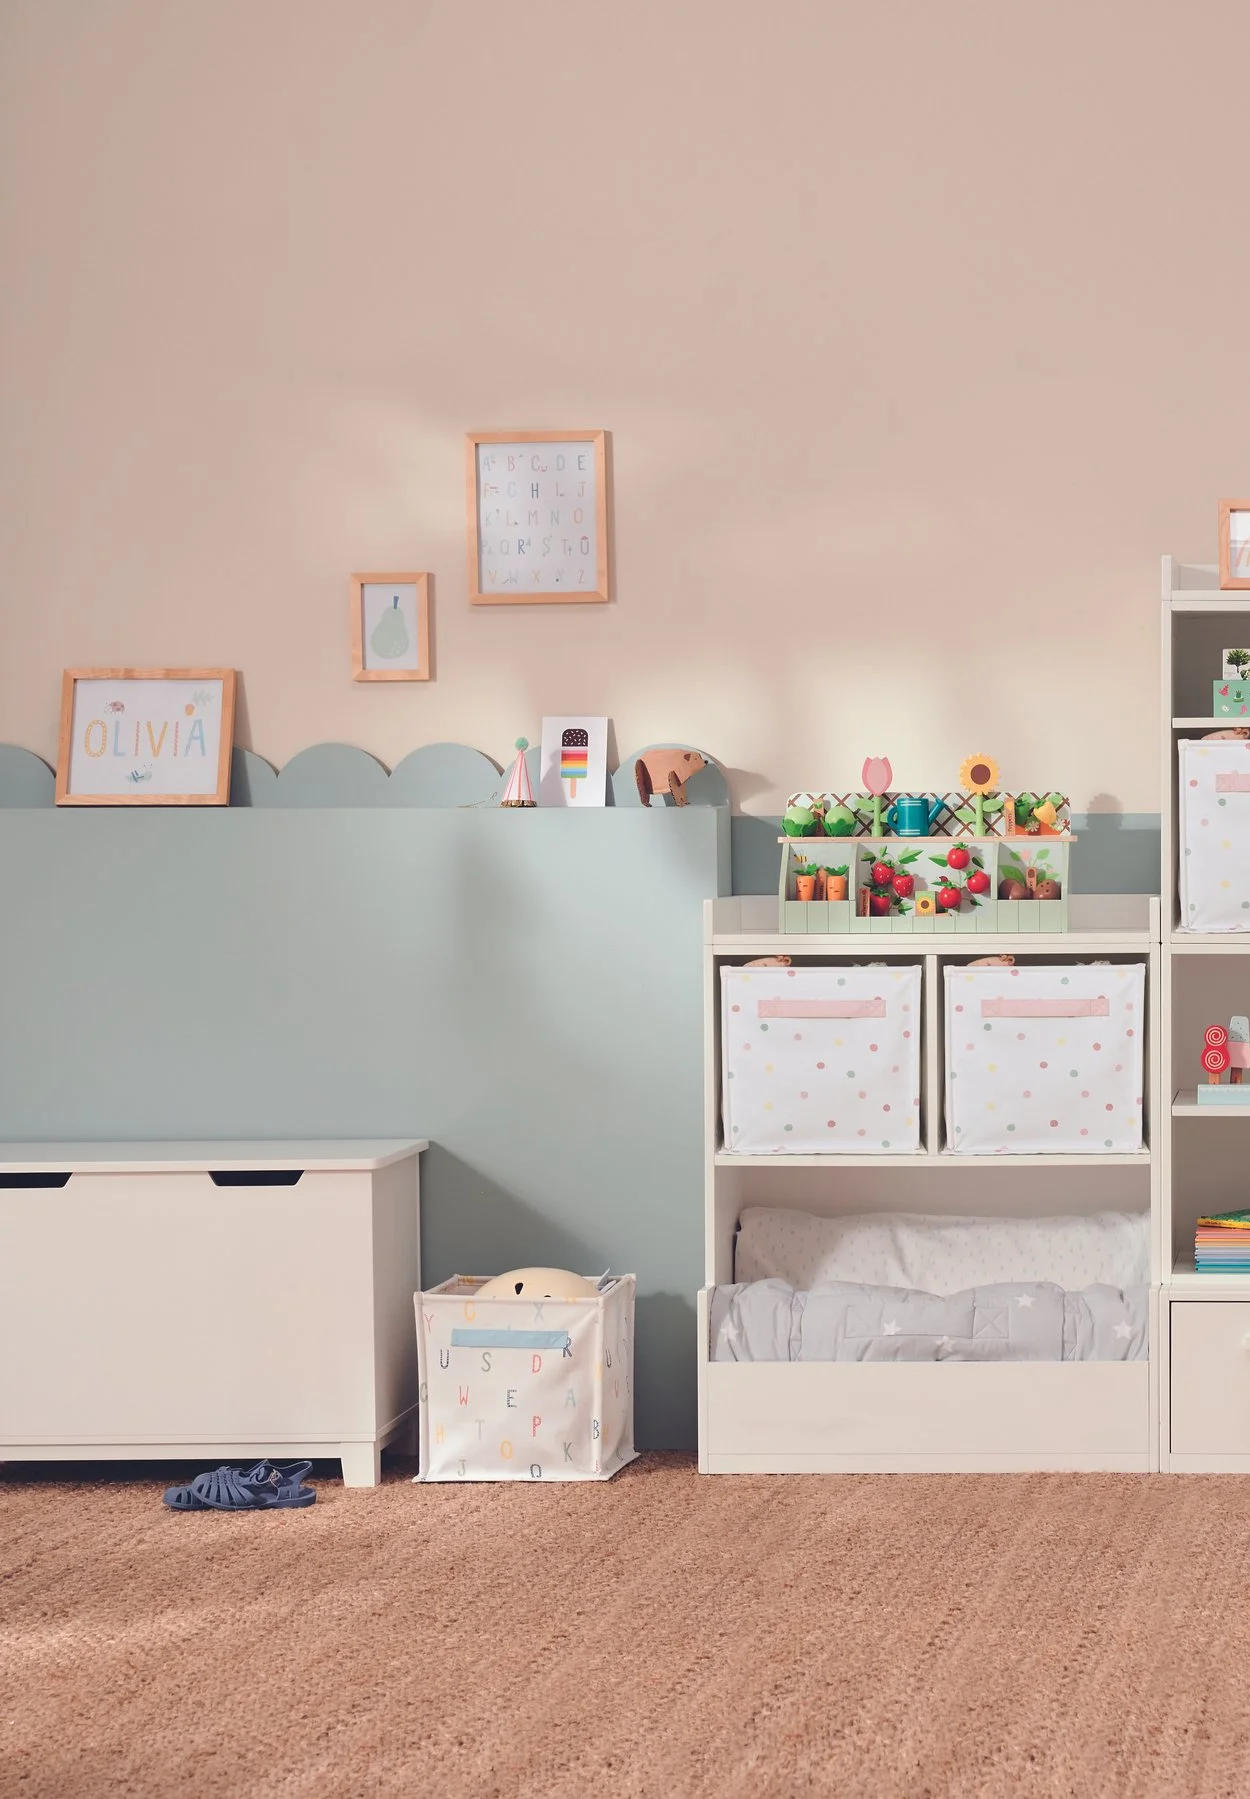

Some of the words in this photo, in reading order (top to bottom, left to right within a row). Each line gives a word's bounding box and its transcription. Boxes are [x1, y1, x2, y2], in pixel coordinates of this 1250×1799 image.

[508, 456, 516, 472] B
[557, 454, 566, 471] D
[577, 455, 586, 471] E
[531, 482, 539, 499] H
[577, 481, 586, 498] J
[528, 510, 538, 525] M
[551, 510, 560, 525] N
[573, 508, 583, 524] O
[518, 539, 525, 555] R
[580, 540, 589, 555] U
[578, 570, 585, 583] Z
[84, 718, 206, 758] OLIVIA
[533, 1302, 544, 1322] X
[424, 1313, 434, 1334] Y
[563, 1337, 572, 1358] R
[440, 1349, 449, 1369] U
[481, 1352, 491, 1372] S
[532, 1354, 541, 1373] D
[459, 1386, 469, 1406] W
[507, 1389, 517, 1408] E
[565, 1388, 576, 1408] A
[436, 1424, 444, 1444] H
[475, 1419, 485, 1440] T
[532, 1416, 541, 1437] P
[593, 1419, 600, 1439] B
[501, 1440, 512, 1459] O
[564, 1442, 573, 1462] K
[458, 1459, 467, 1476] J
